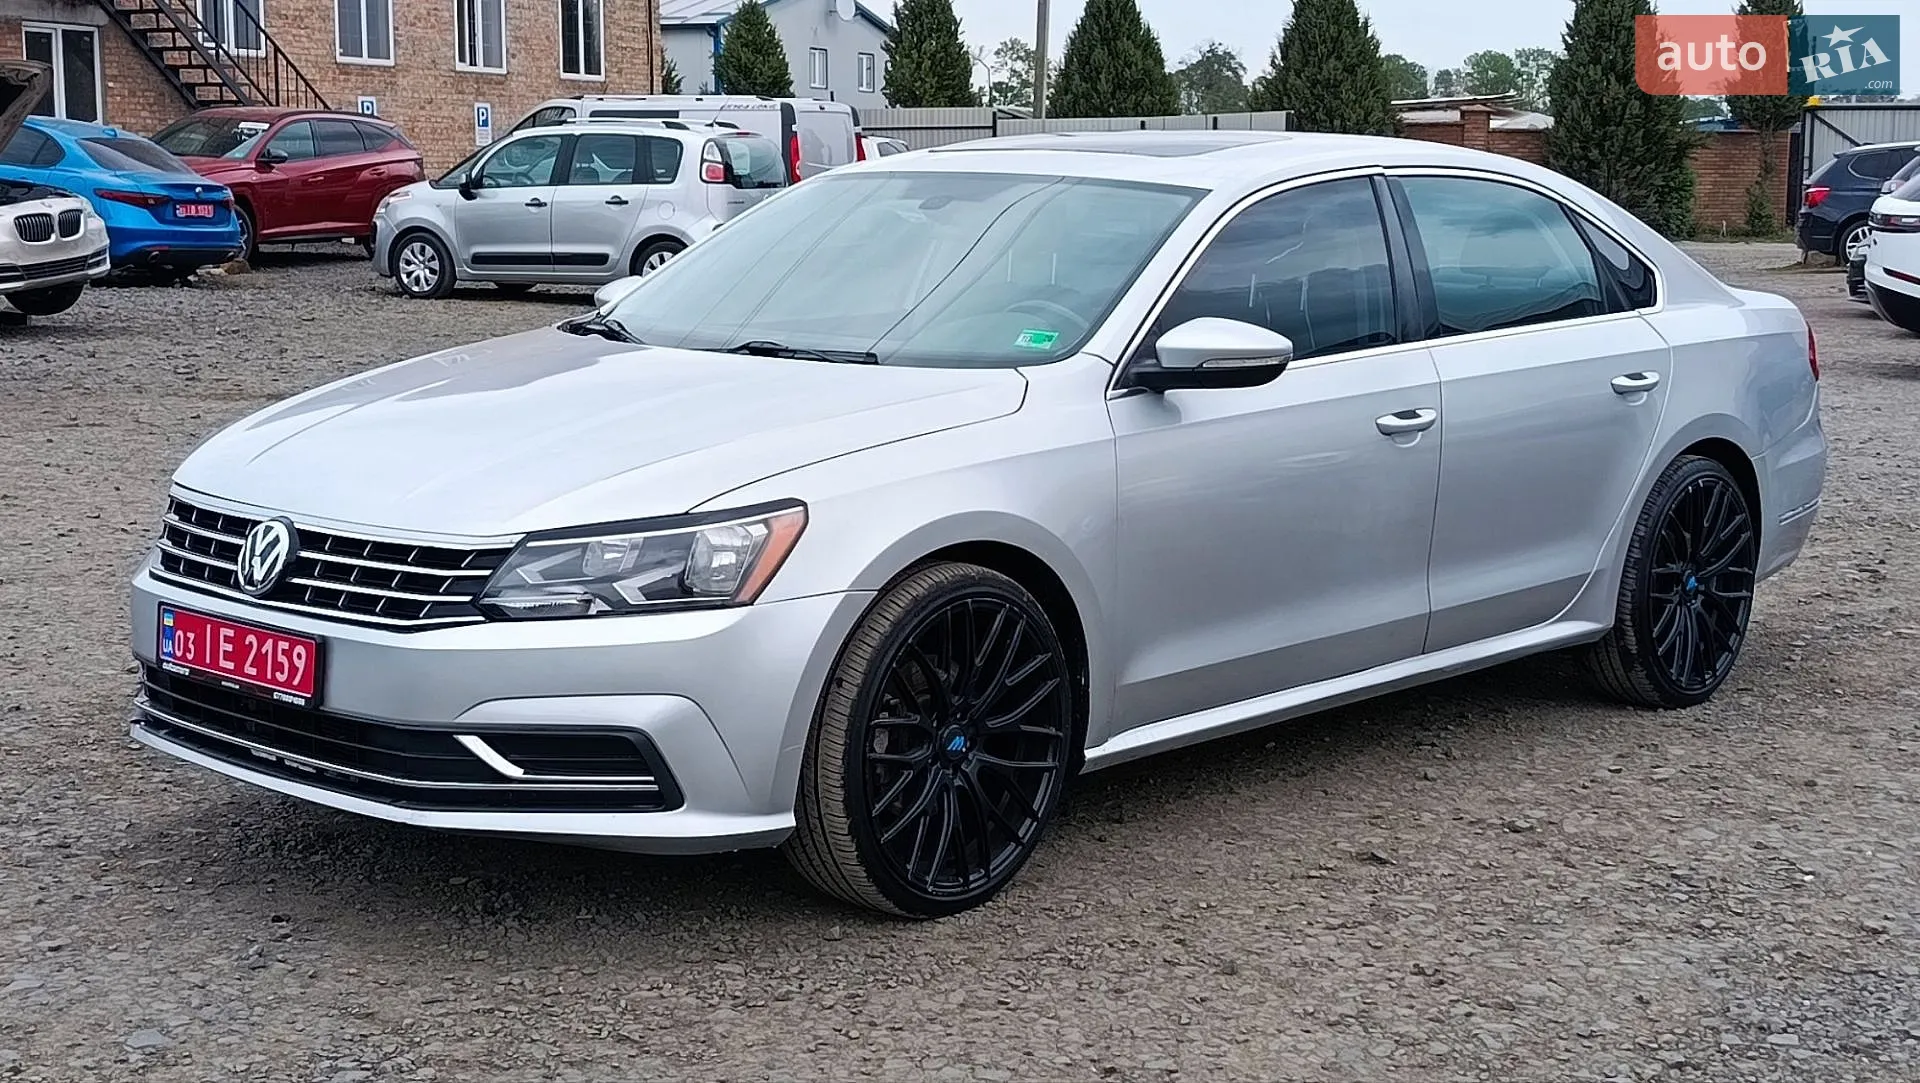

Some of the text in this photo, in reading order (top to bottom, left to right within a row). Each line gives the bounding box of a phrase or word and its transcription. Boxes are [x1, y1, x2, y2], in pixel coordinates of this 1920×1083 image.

[479, 108, 487, 126] P
[163, 639, 173, 654] UA
[175, 624, 306, 686] 03 IE 2159
